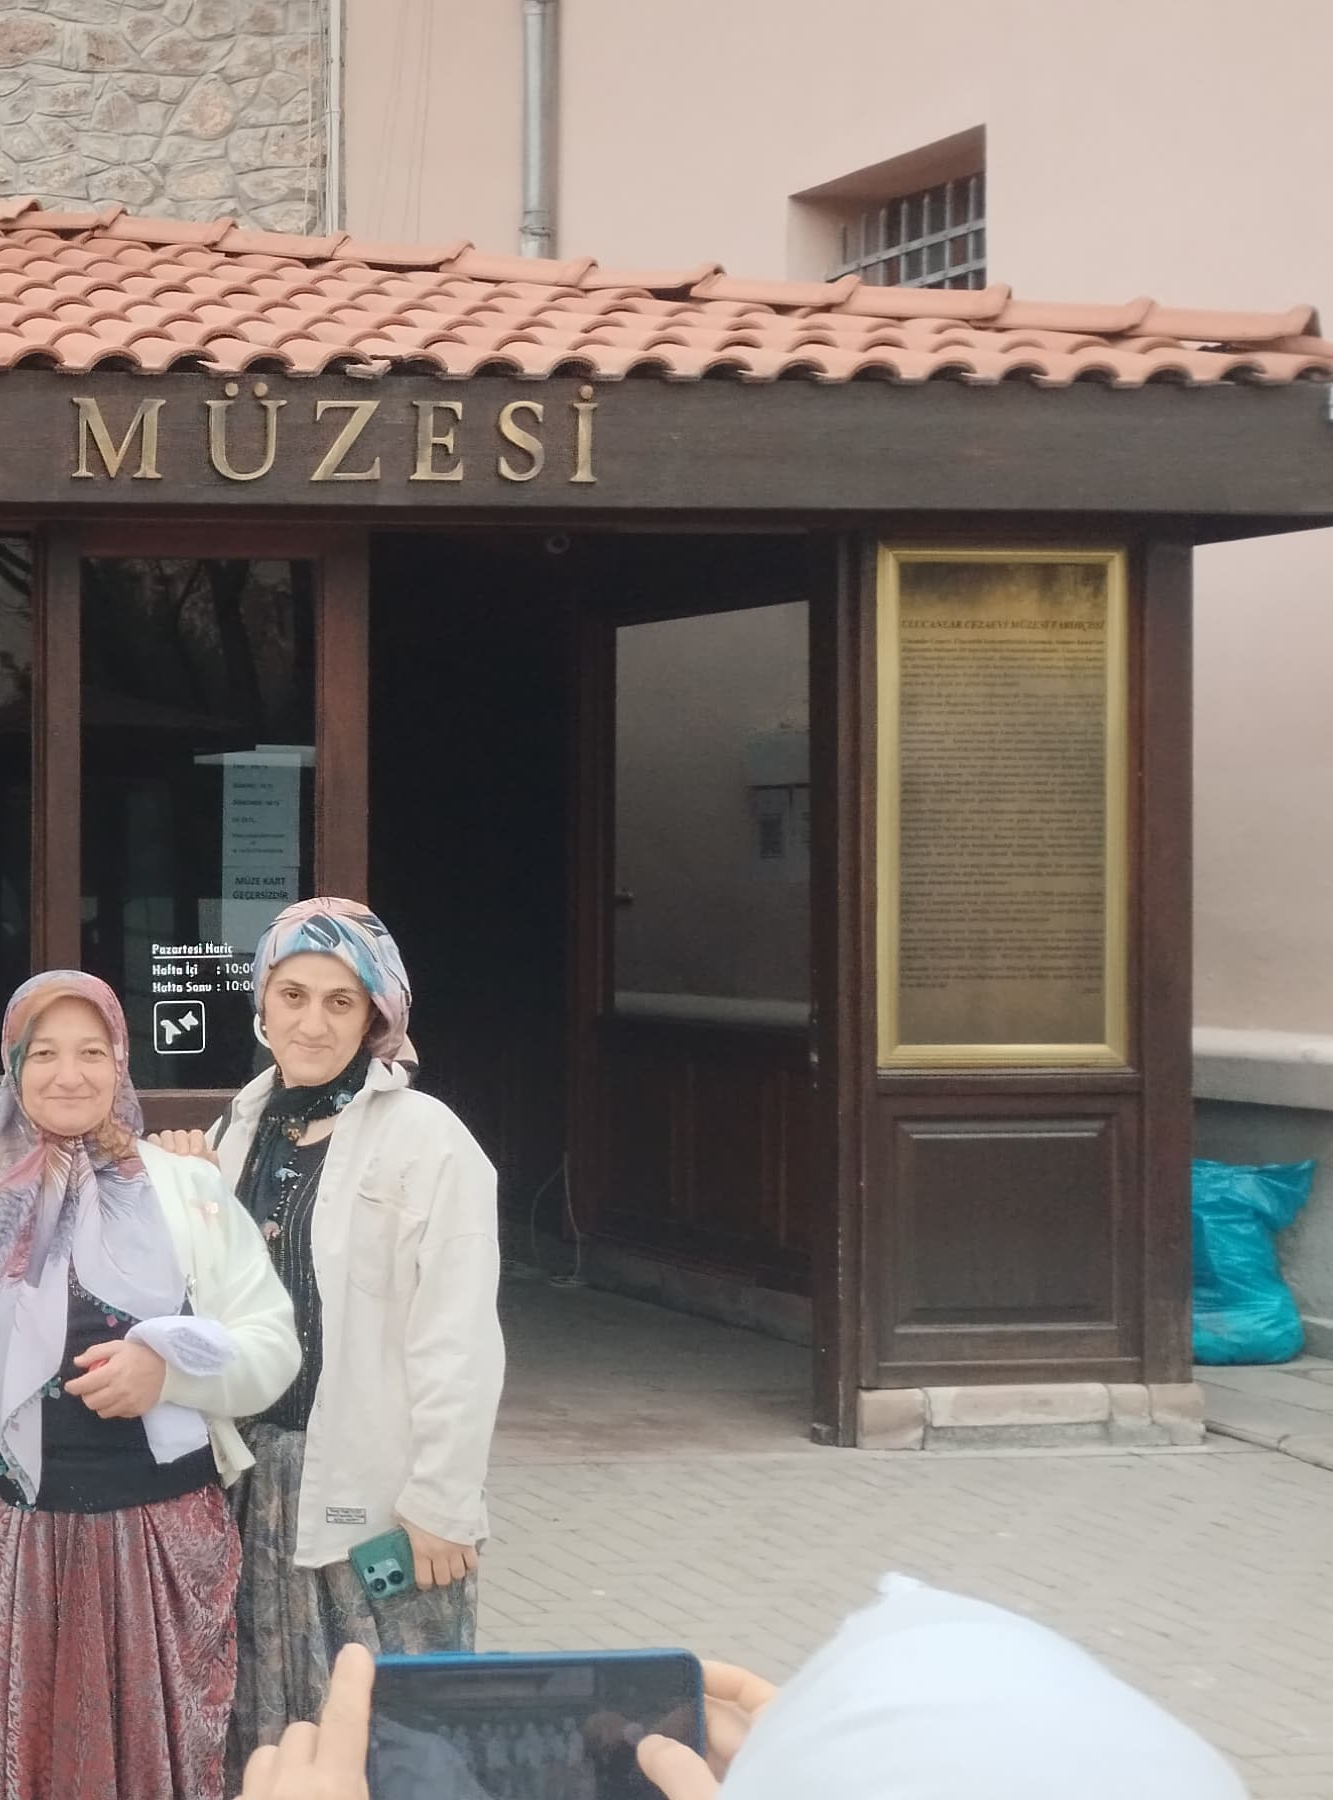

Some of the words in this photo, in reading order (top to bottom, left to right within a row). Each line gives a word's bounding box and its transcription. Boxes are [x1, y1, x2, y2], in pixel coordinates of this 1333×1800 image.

[71, 381, 599, 484] MÜZESİ
[152, 943, 203, 955] Pazartesi
[152, 963, 183, 976] Hafta
[152, 981, 183, 993] Hafta
[185, 981, 212, 992] Sonu
